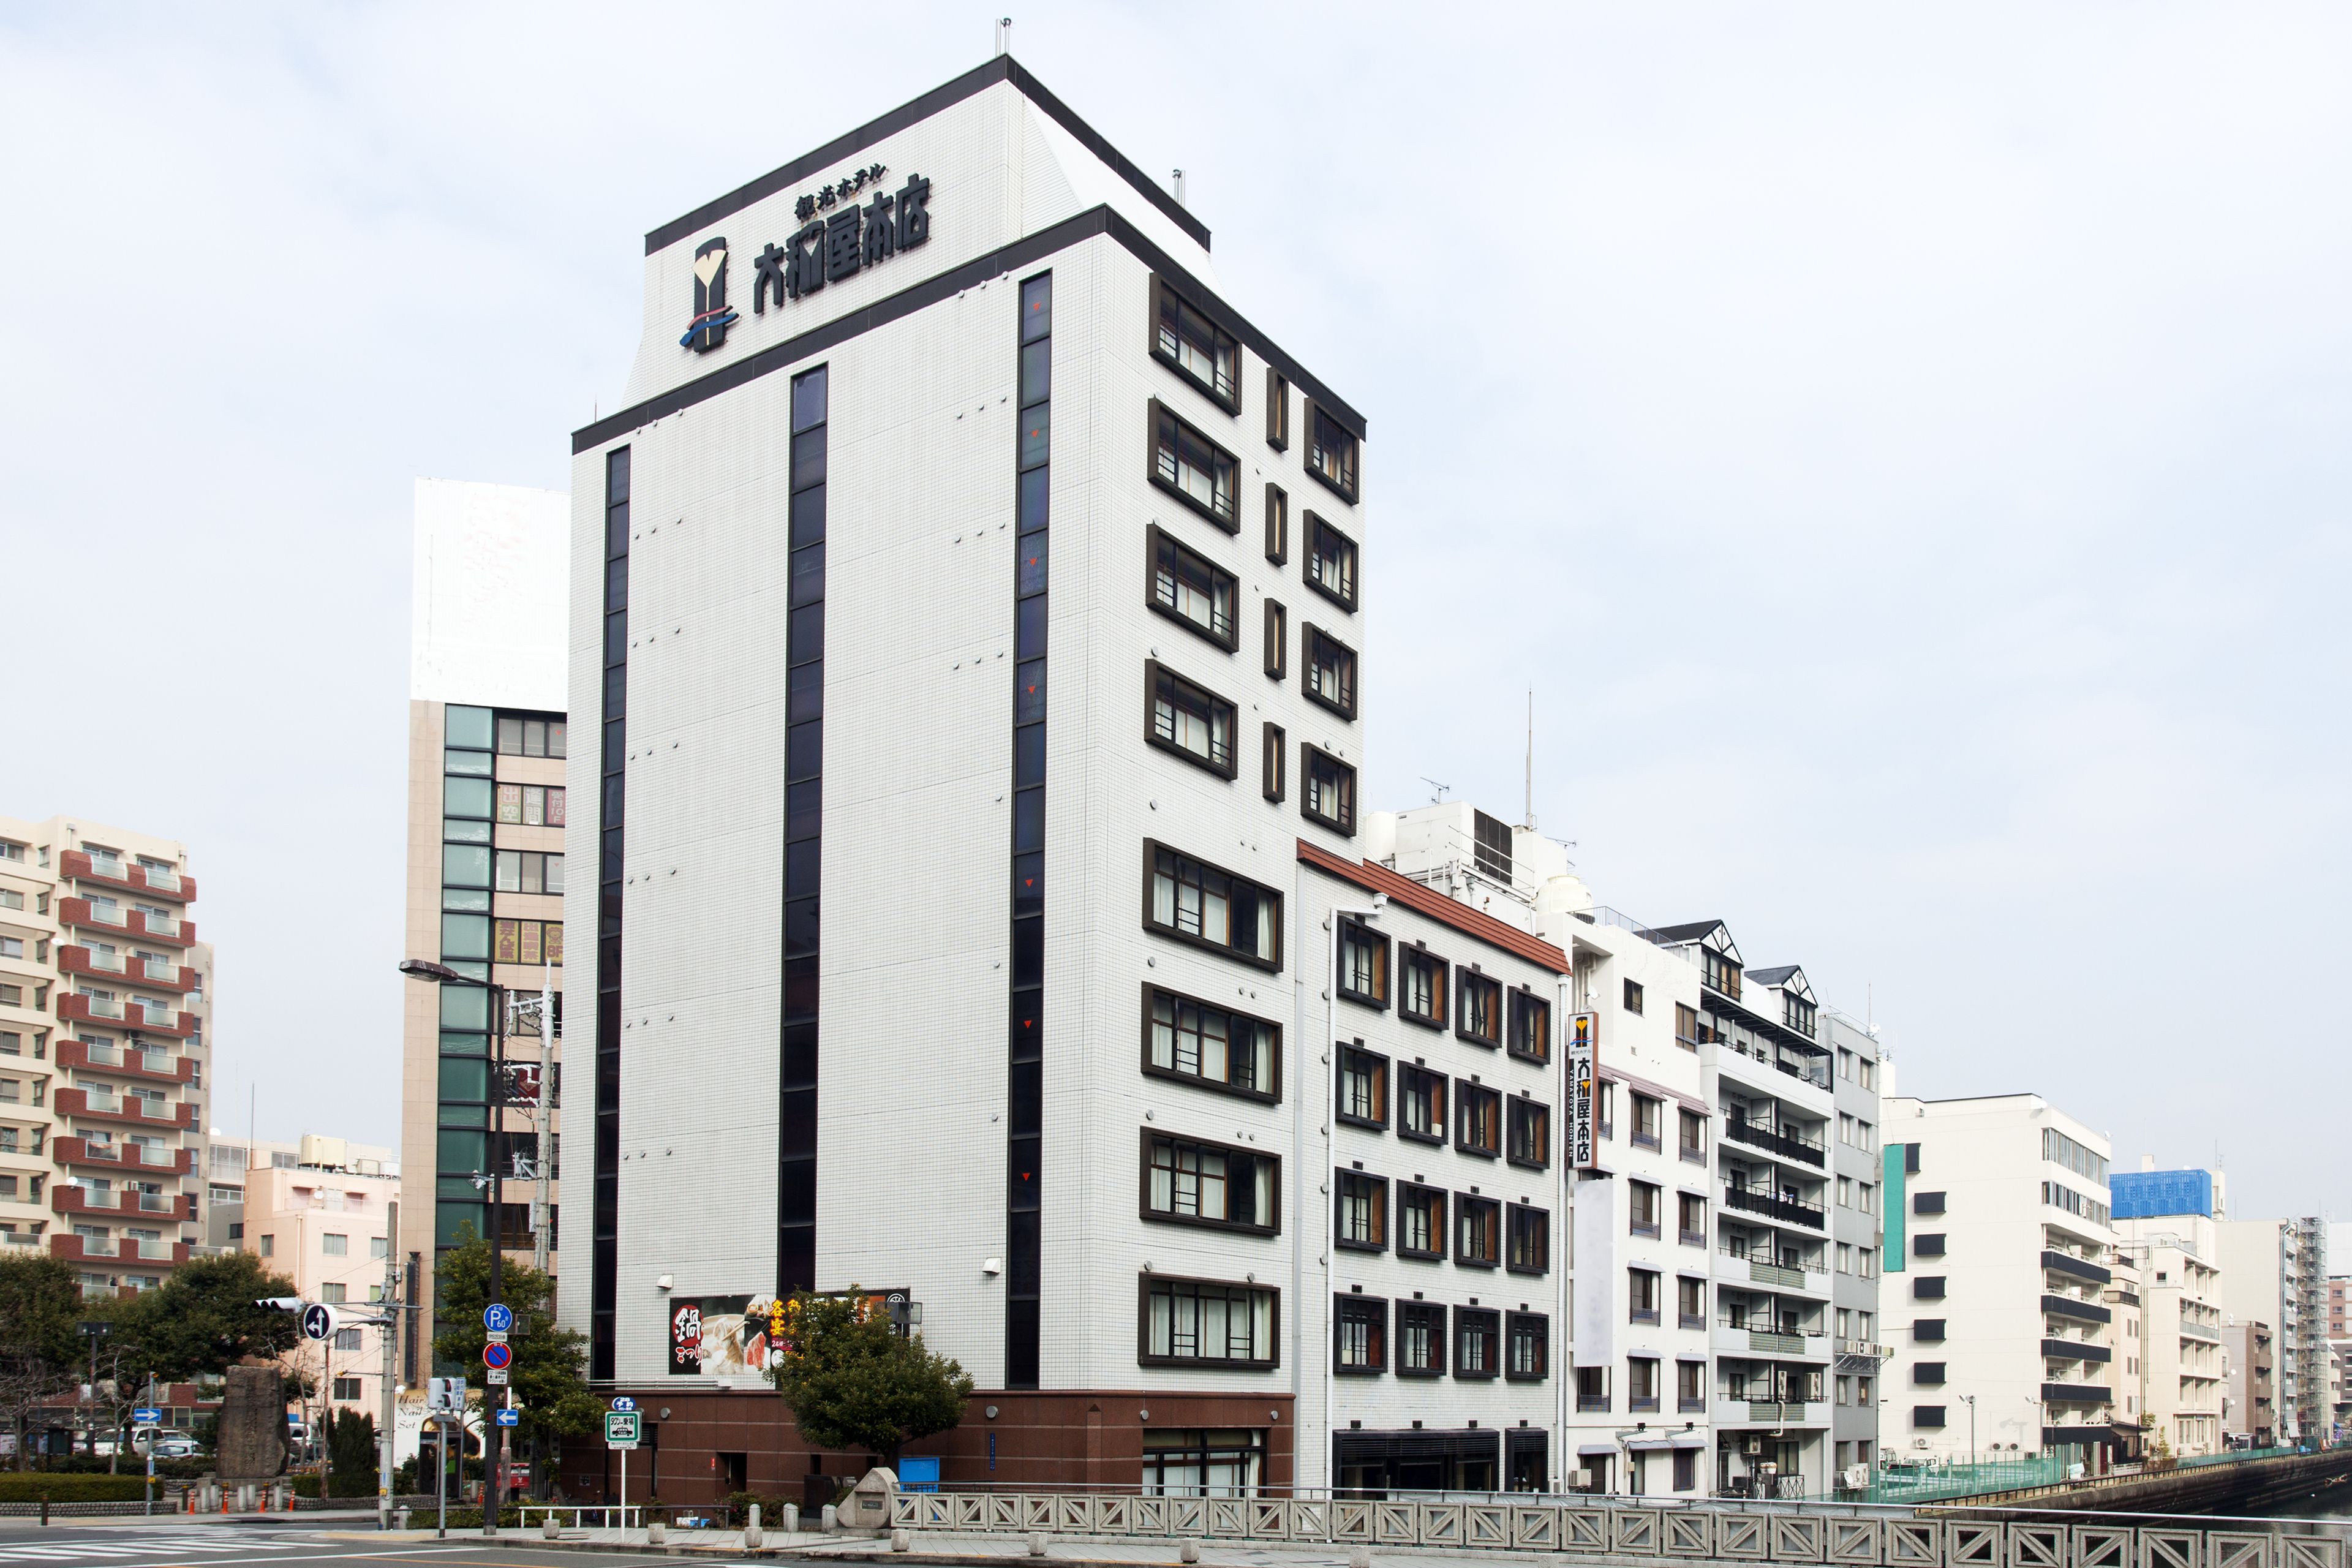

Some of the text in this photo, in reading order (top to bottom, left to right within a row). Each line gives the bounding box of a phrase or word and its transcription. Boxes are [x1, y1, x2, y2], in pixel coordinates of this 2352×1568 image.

[794, 163, 886, 220] 観光ホテル
[753, 173, 930, 314] 大和屋本店
[547, 944, 563, 957] 8F
[1577, 1057, 1591, 1162] 大和屋本店
[491, 1311, 501, 1327] P
[674, 1308, 702, 1343] 鍋
[675, 1344, 703, 1366] まつり
[399, 1395, 424, 1404] Hair
[398, 1407, 423, 1416] Nail
[398, 1420, 416, 1429] Set
